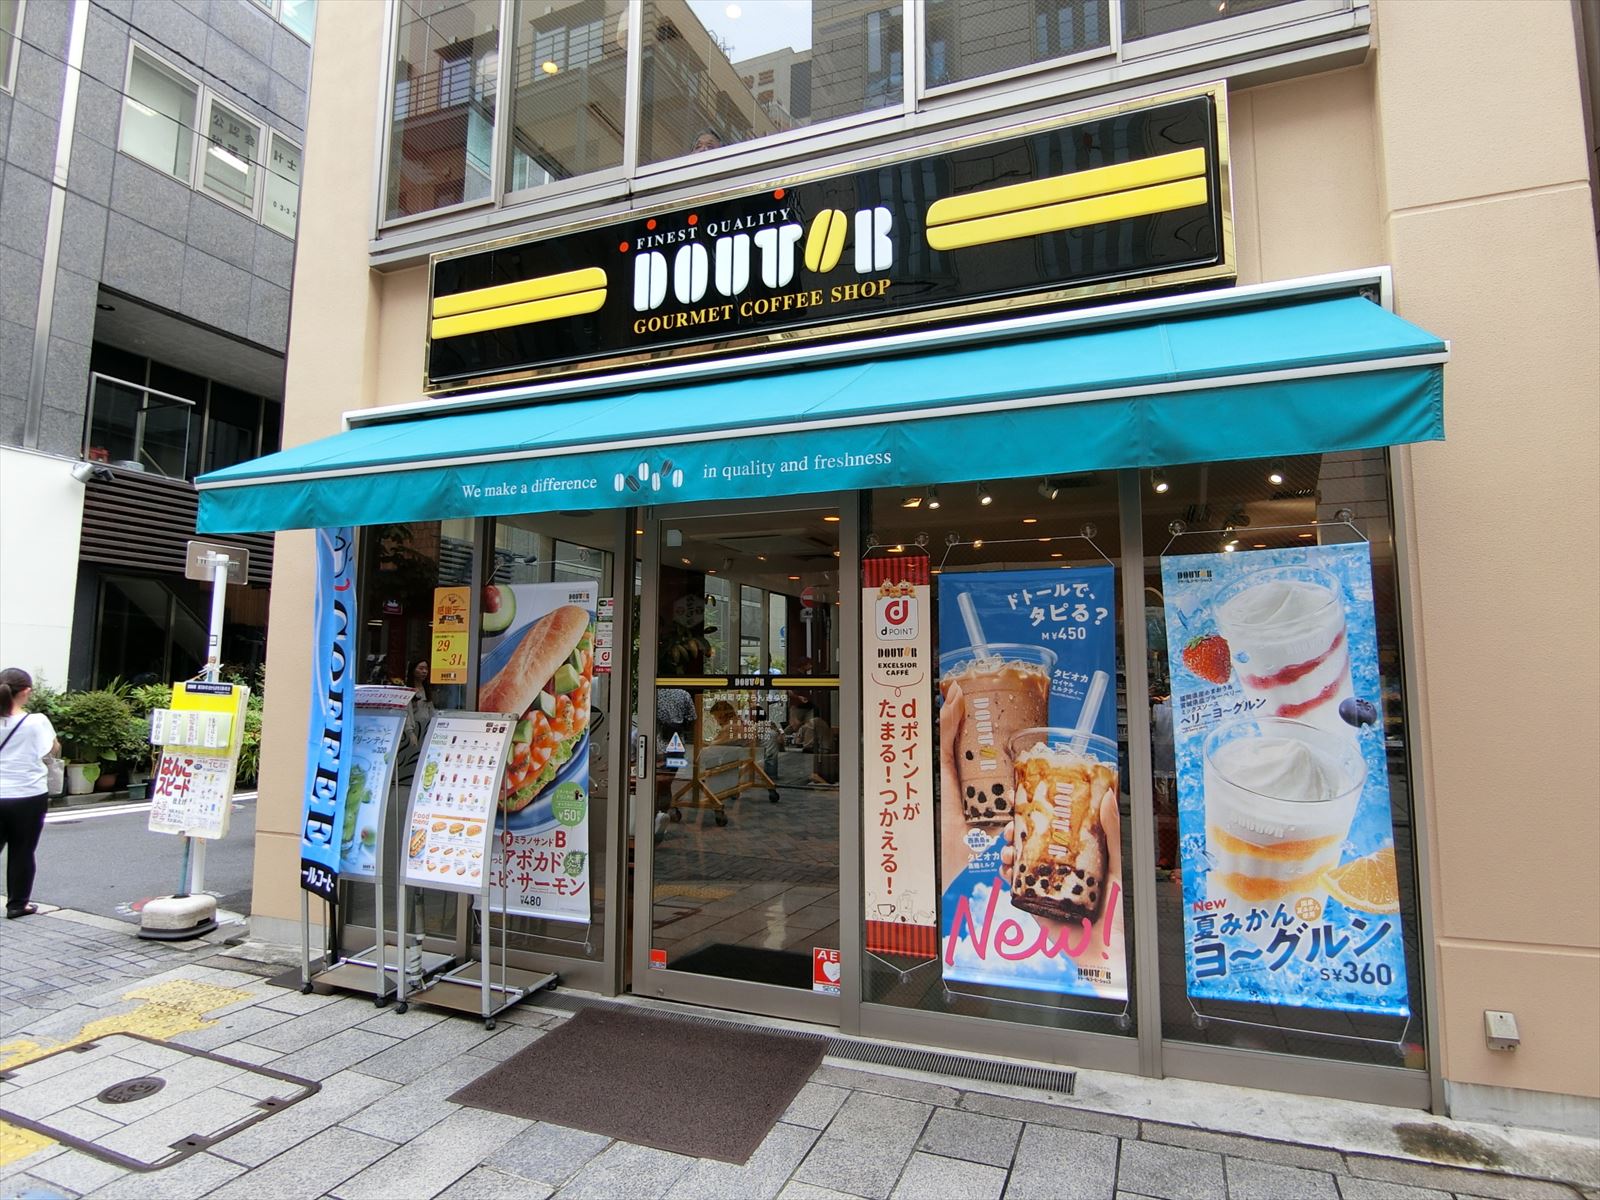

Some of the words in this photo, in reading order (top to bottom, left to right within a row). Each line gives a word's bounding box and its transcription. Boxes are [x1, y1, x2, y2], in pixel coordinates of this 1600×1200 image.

[636, 227, 698, 250] FINEST
[706, 207, 791, 235] QUALITY
[633, 207, 893, 312] DOUTOR
[633, 304, 734, 335] GOURMET
[740, 289, 823, 317] COFFEE
[830, 278, 892, 304] SHOP
[702, 464, 719, 478] in
[722, 460, 776, 481] quality
[780, 456, 808, 472] and
[813, 450, 892, 470] freshness
[462, 485, 481, 498] We
[484, 482, 518, 497] make
[521, 485, 528, 495] a
[531, 475, 598, 493] difference
[436, 640, 451, 652] 29
[877, 647, 918, 658] DOUTOR
[973, 697, 998, 772] DOUTOR
[160, 757, 193, 777] はんこ
[901, 698, 921, 821] dポイントが
[156, 776, 191, 798] スピード
[1192, 899, 1227, 913] New
[1193, 903, 1295, 943] 夏みかん
